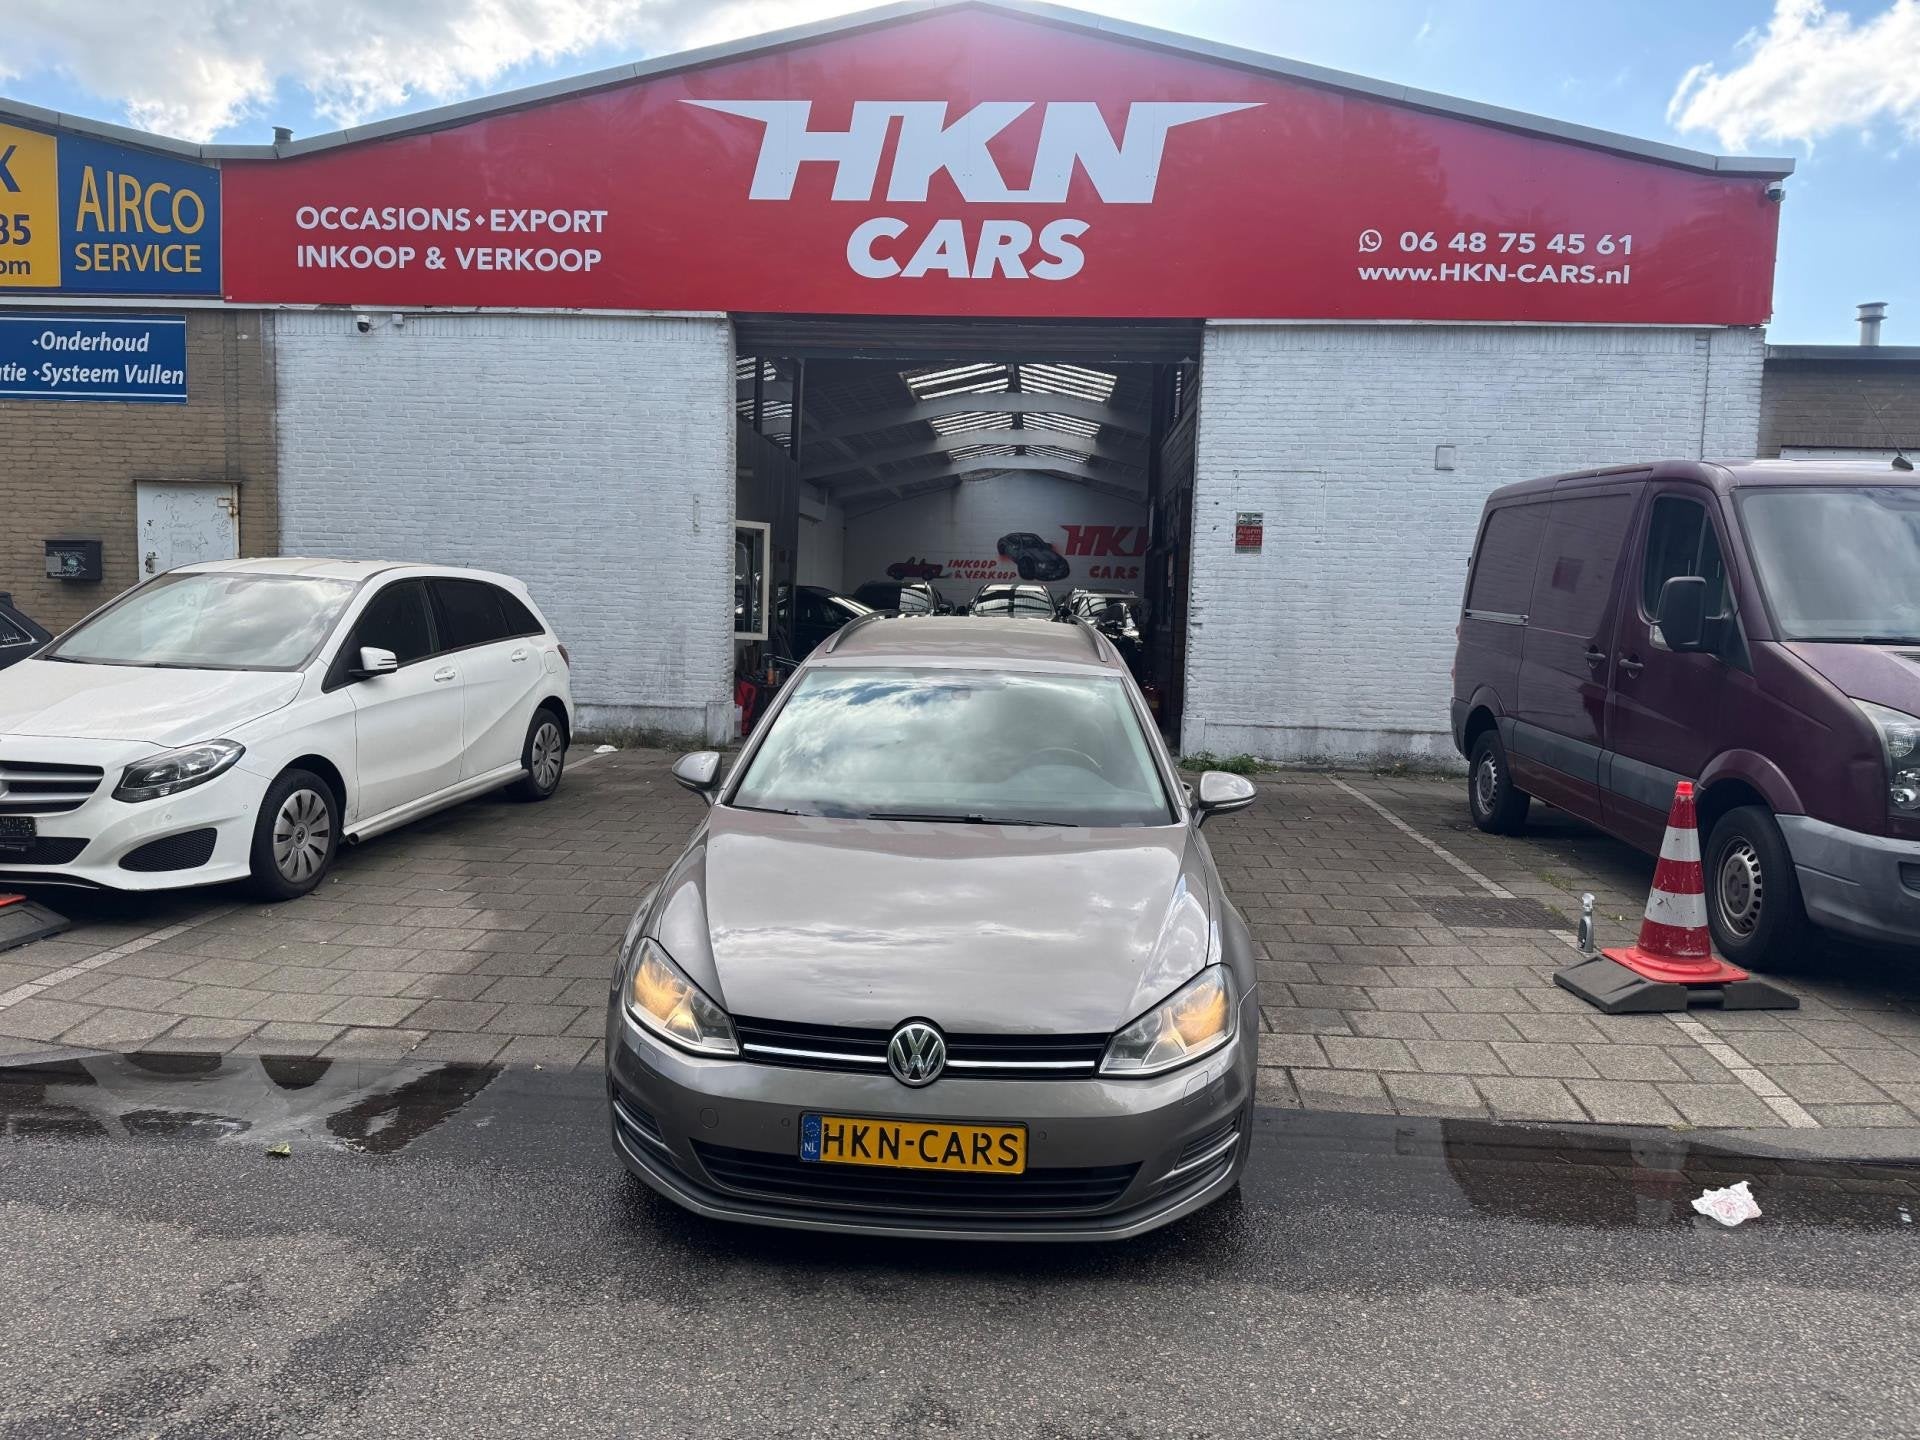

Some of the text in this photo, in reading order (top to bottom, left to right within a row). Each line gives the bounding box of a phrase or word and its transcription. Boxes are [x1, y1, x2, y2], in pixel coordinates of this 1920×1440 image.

[677, 99, 1268, 204] HKN
[76, 165, 205, 234] AIRCO
[295, 206, 608, 233] OCCASIONS EXPORT
[846, 216, 1091, 280] CARS
[1400, 231, 1632, 255] 06 48 75 45 61
[75, 242, 202, 273] SERVICE
[297, 245, 602, 272] INKOOP & VERKOOP
[1358, 263, 1630, 285] www.HKN-CARS.nl
[0, 362, 184, 387] tie Systeem Vullen
[947, 559, 997, 569] INKOOP
[965, 570, 1017, 580] VERKOOP
[1089, 565, 1140, 579] CARS
[804, 1123, 1019, 1167] NL HKN-CARS
